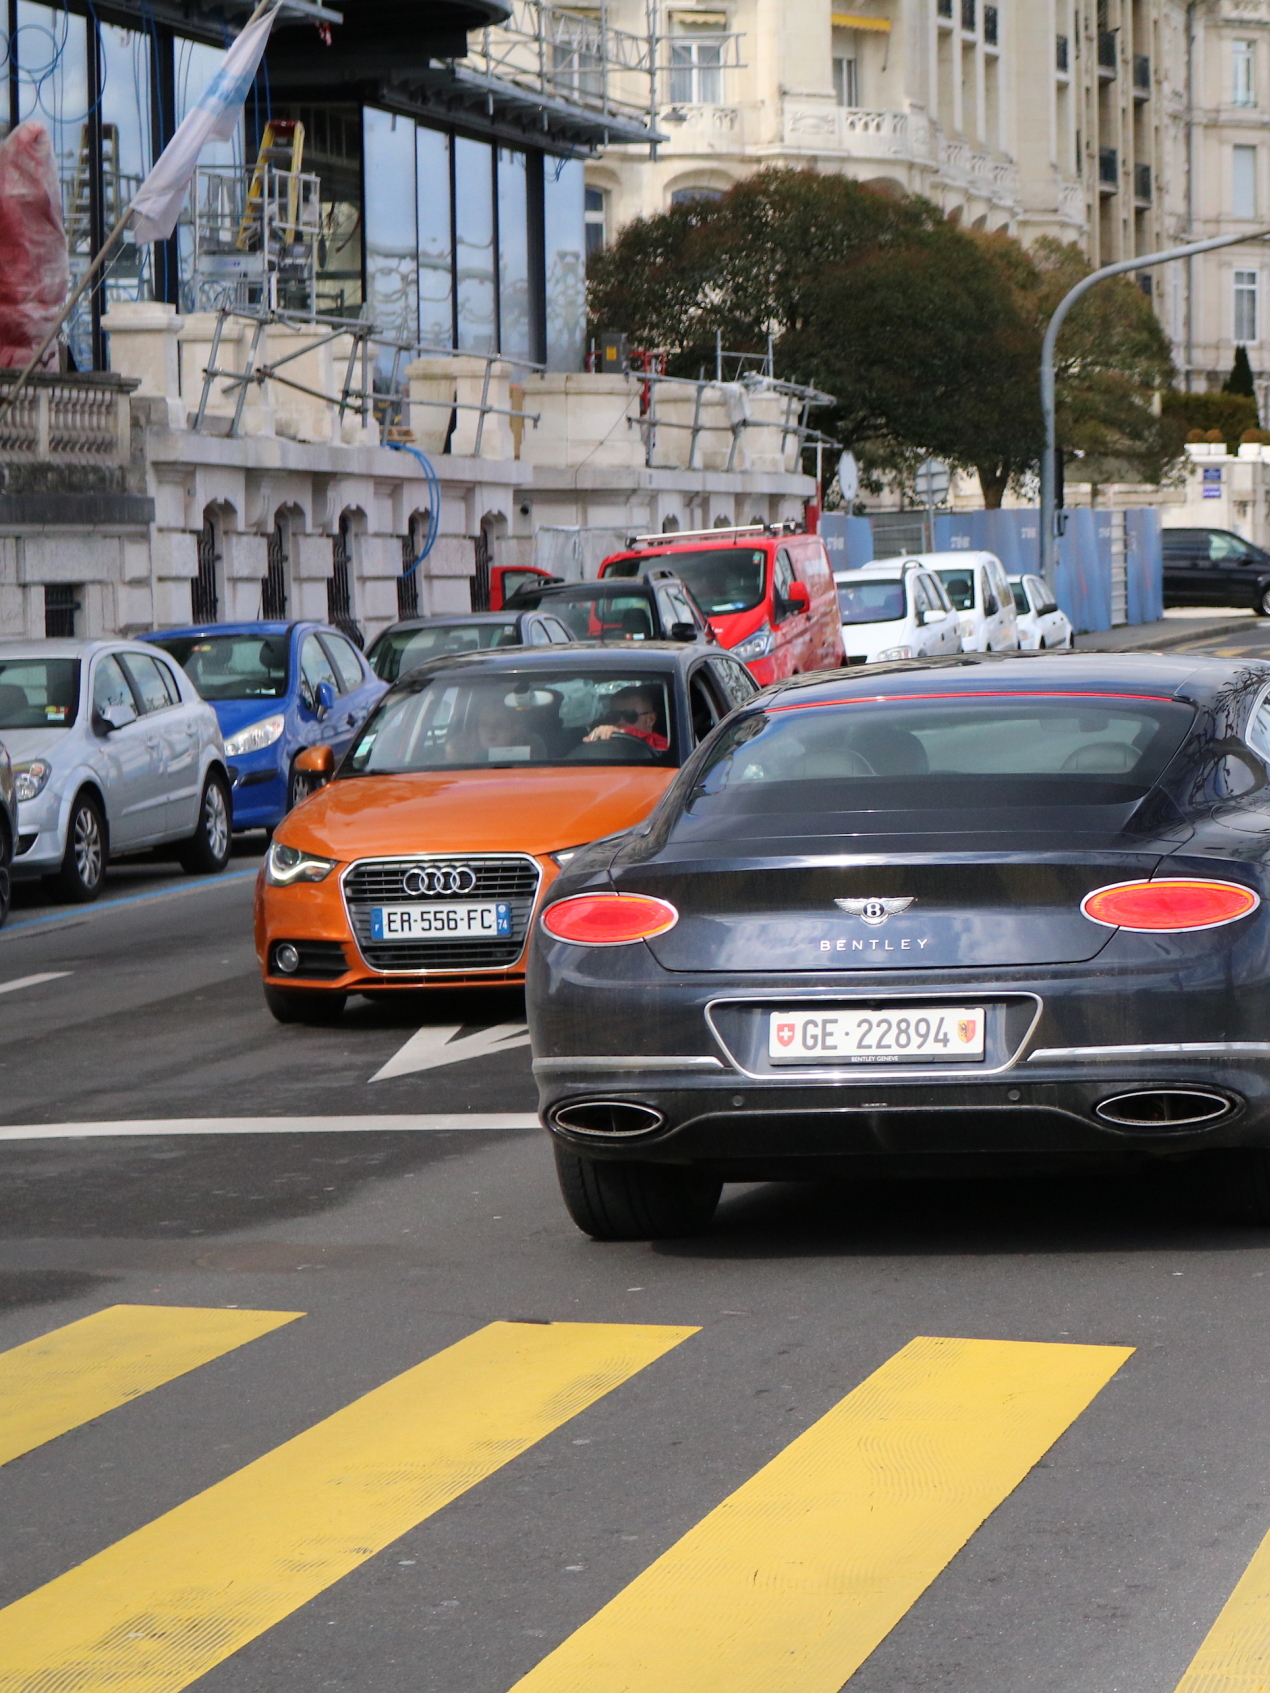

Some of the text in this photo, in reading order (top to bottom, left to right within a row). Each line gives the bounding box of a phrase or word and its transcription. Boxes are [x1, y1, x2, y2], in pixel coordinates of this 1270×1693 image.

[866, 904, 881, 917] B
[387, 909, 493, 933] ER-556-FC
[497, 918, 508, 930] 74
[820, 938, 928, 951] BENTLEY
